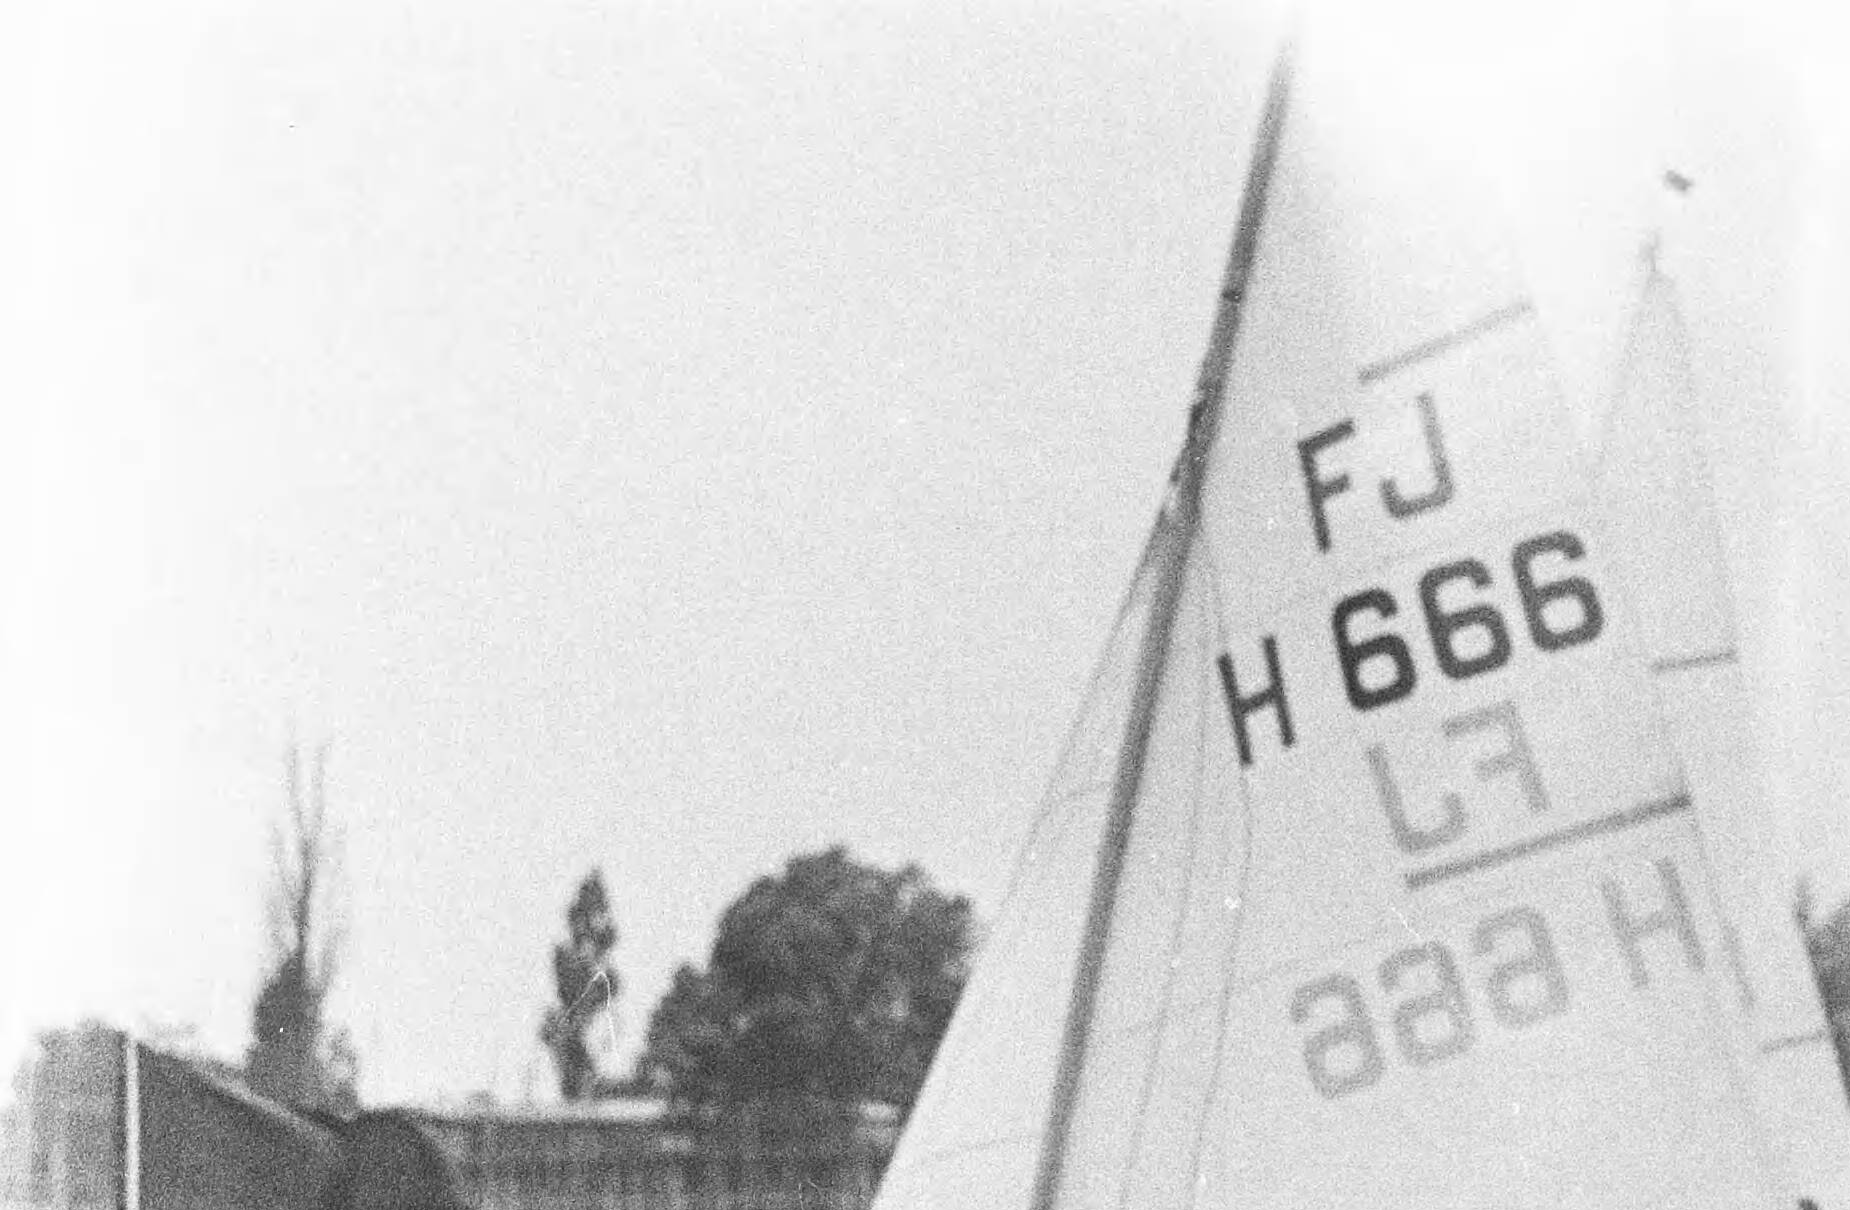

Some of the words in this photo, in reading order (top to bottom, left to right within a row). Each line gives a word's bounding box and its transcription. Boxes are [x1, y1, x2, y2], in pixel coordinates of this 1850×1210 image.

[1298, 393, 1455, 554] FJ
[1216, 635, 1297, 767] H
[1331, 530, 1605, 713] 666
